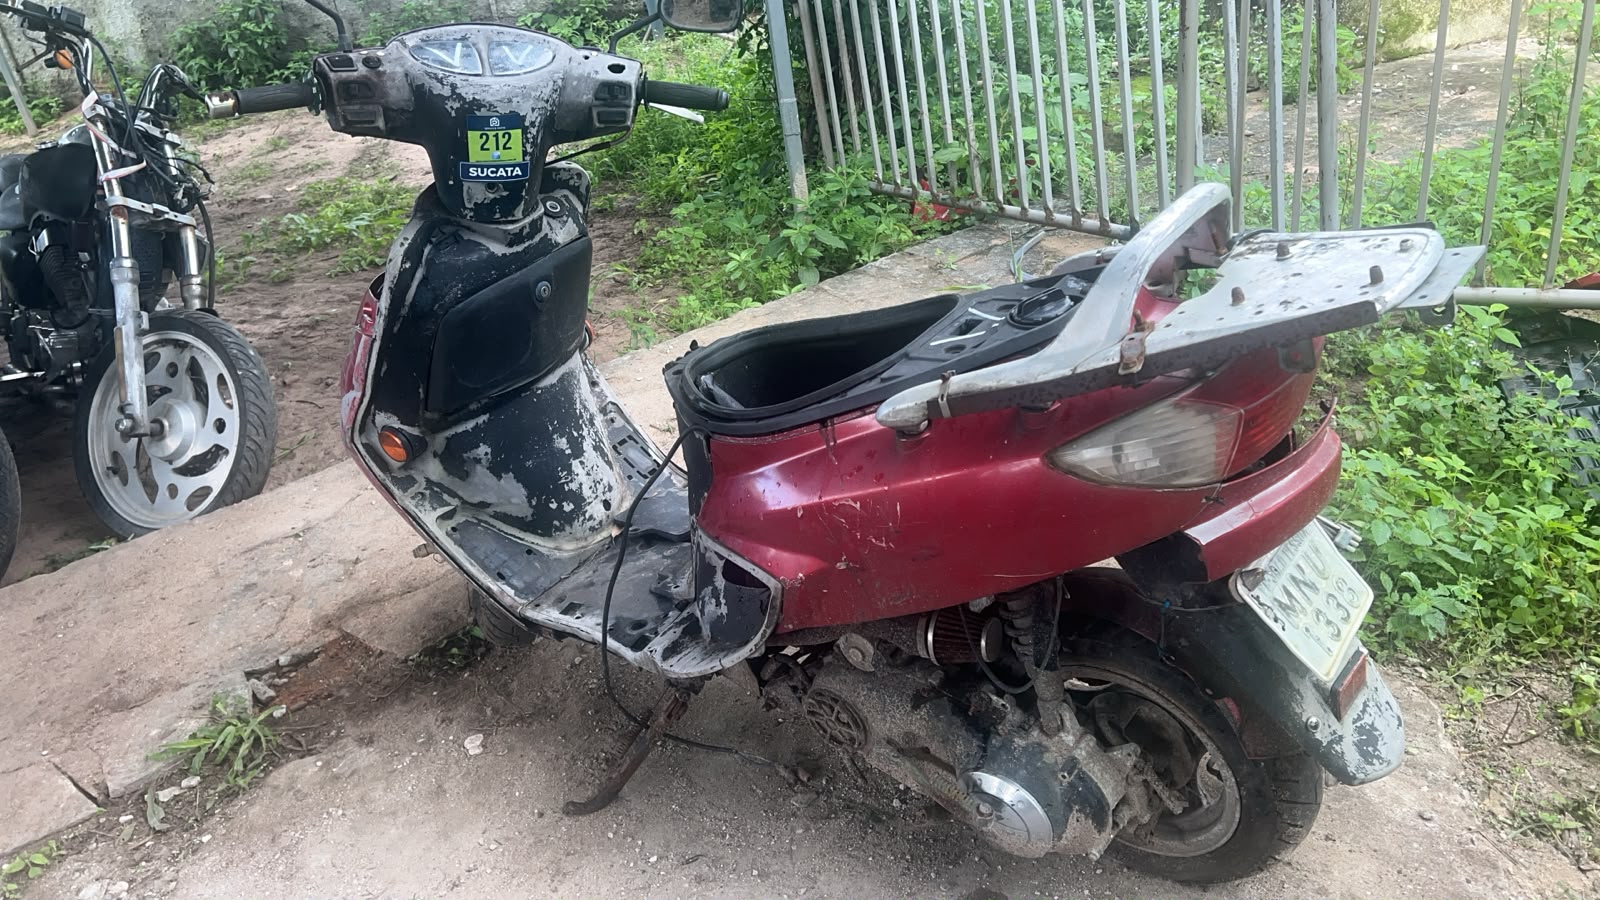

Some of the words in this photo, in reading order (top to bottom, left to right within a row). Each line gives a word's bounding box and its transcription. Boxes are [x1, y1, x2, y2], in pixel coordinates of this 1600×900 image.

[479, 131, 512, 151] 212
[468, 166, 522, 177] SUCATA
[1272, 542, 1329, 630] MNU
